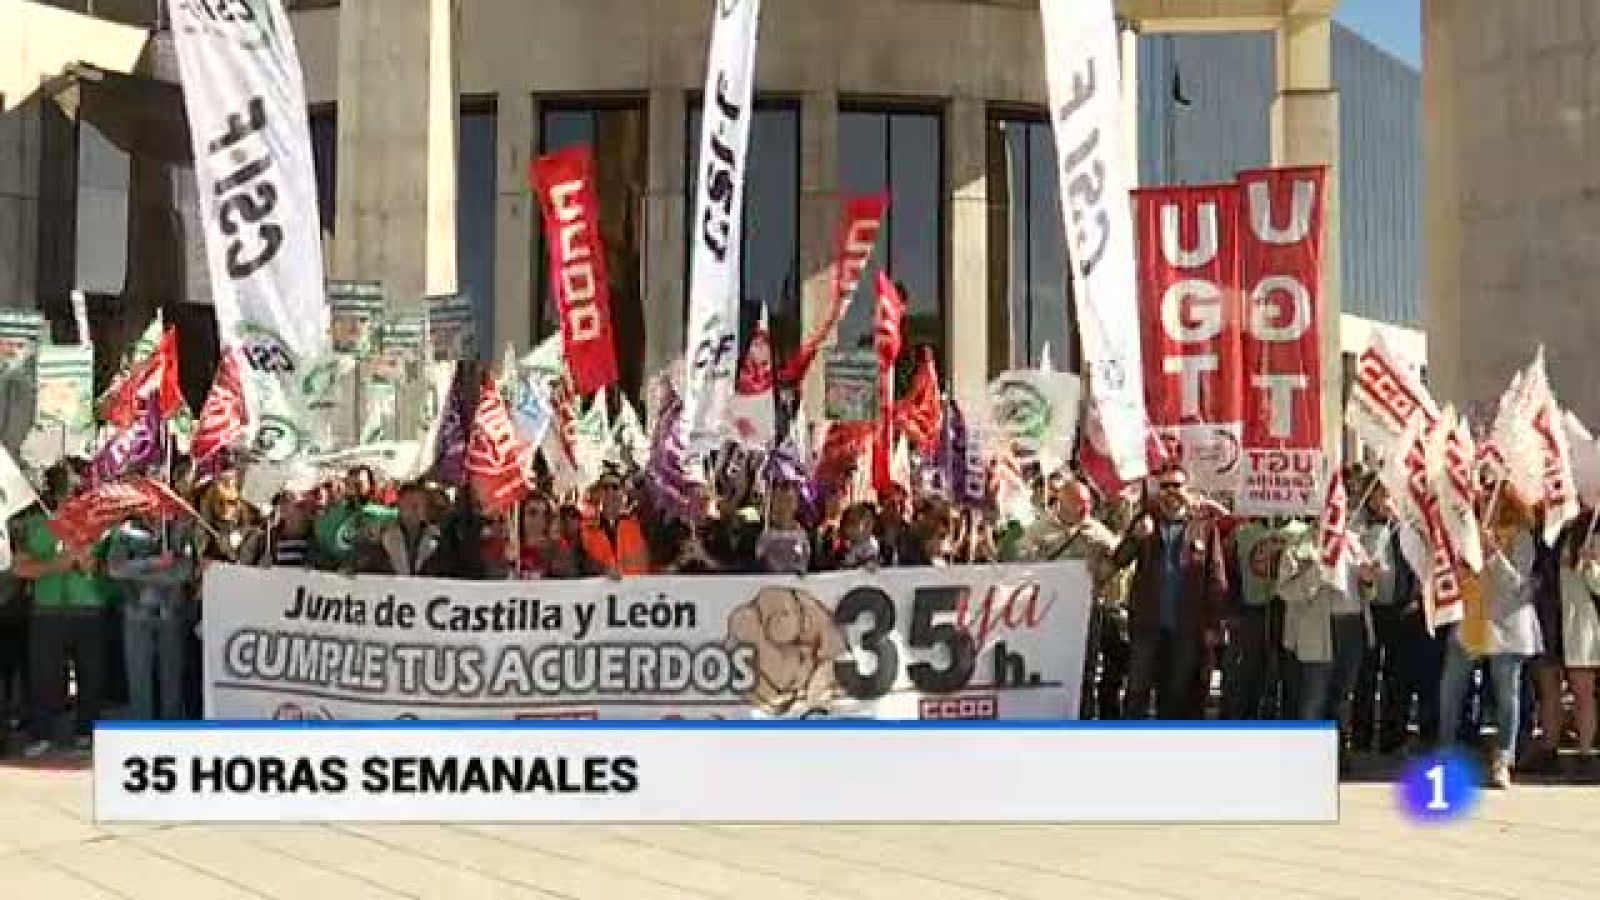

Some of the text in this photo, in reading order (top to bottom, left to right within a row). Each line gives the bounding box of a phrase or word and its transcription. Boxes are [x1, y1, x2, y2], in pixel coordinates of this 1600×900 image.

[1160, 201, 1222, 425] UGT
[284, 585, 697, 640] Junta de Castilla y León
[833, 585, 978, 700] 35
[225, 629, 760, 697] CUMPLE TUS ACUERDOS
